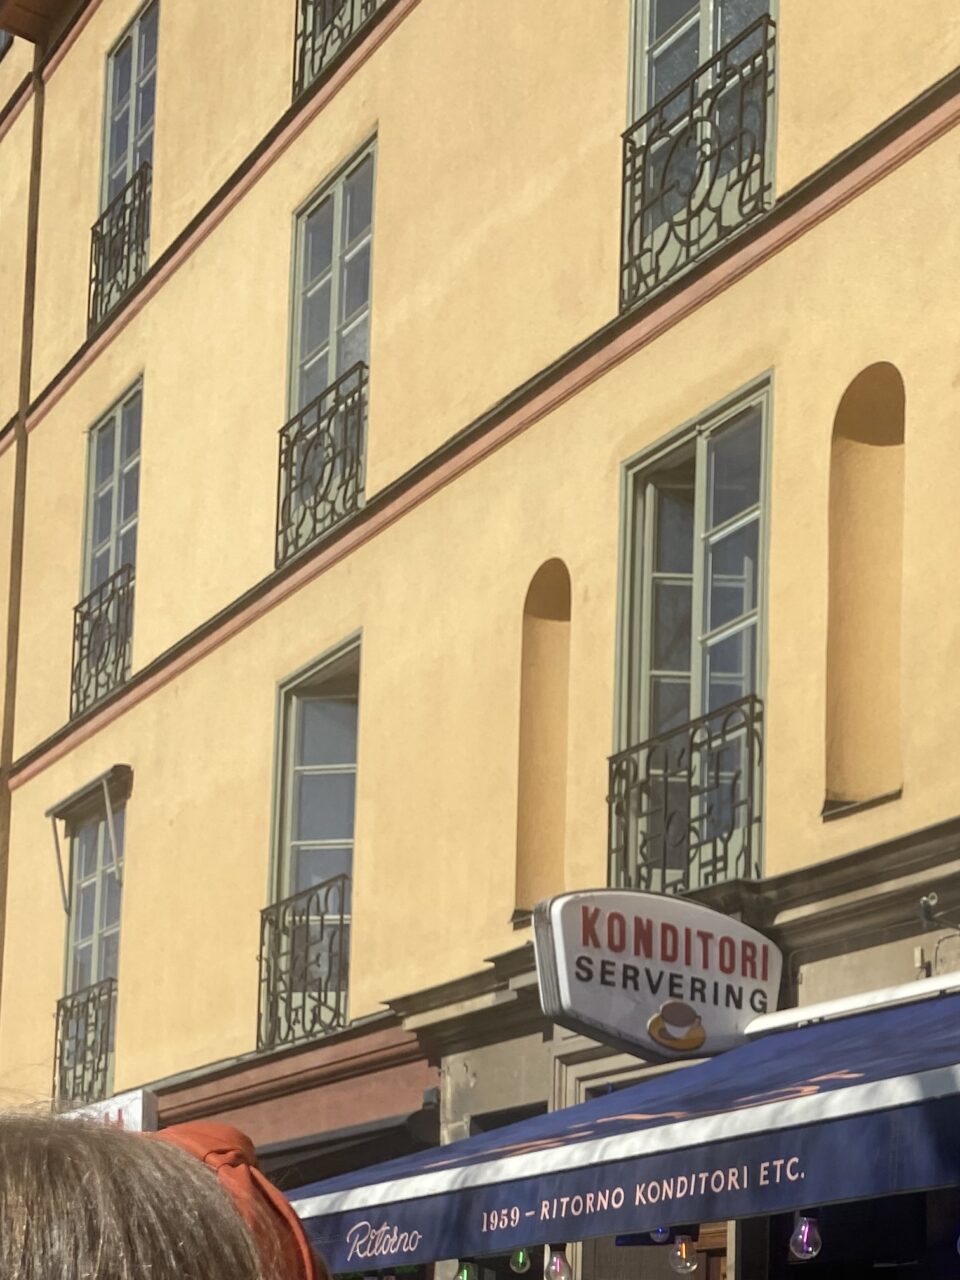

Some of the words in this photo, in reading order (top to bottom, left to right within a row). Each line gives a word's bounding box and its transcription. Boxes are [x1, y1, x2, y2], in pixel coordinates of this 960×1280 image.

[581, 905, 769, 982] KONDITORI
[574, 955, 768, 1014] SERVERING
[481, 1206, 520, 1233] 1959
[540, 1187, 625, 1221] RITORNO
[634, 1165, 748, 1206] KONDITORI
[759, 1156, 806, 1186] ETC.
[346, 1220, 423, 1262] Ritorno
